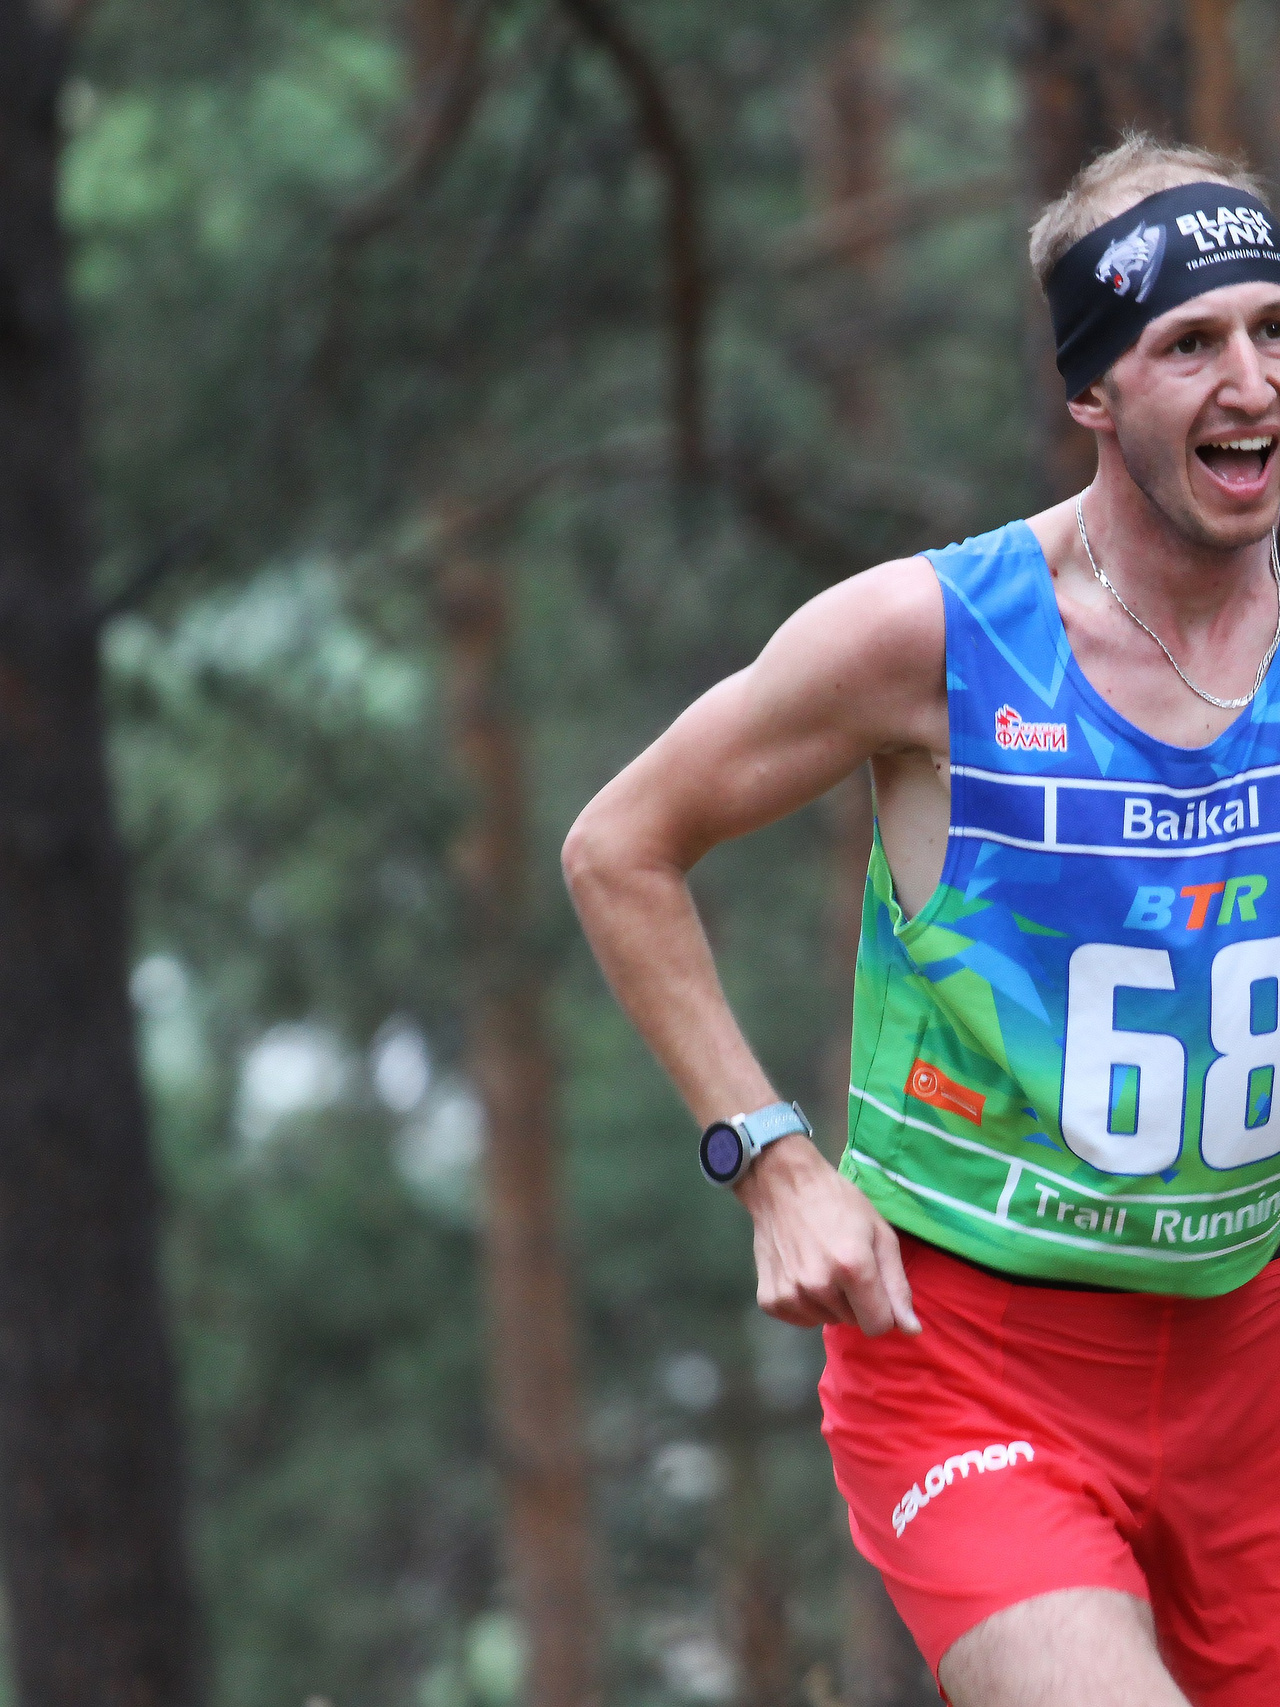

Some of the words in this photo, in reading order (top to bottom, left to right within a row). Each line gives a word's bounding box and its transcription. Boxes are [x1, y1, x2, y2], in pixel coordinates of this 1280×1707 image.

[1176, 206, 1272, 236] BLACK
[1193, 223, 1274, 252] LYNX
[1186, 248, 1261, 271] TRAILRUNNING
[996, 729, 1066, 750] ФЛАГИ
[1123, 785, 1260, 841] Baikal
[1122, 874, 1268, 931] BTR
[1035, 1182, 1127, 1238] Trail
